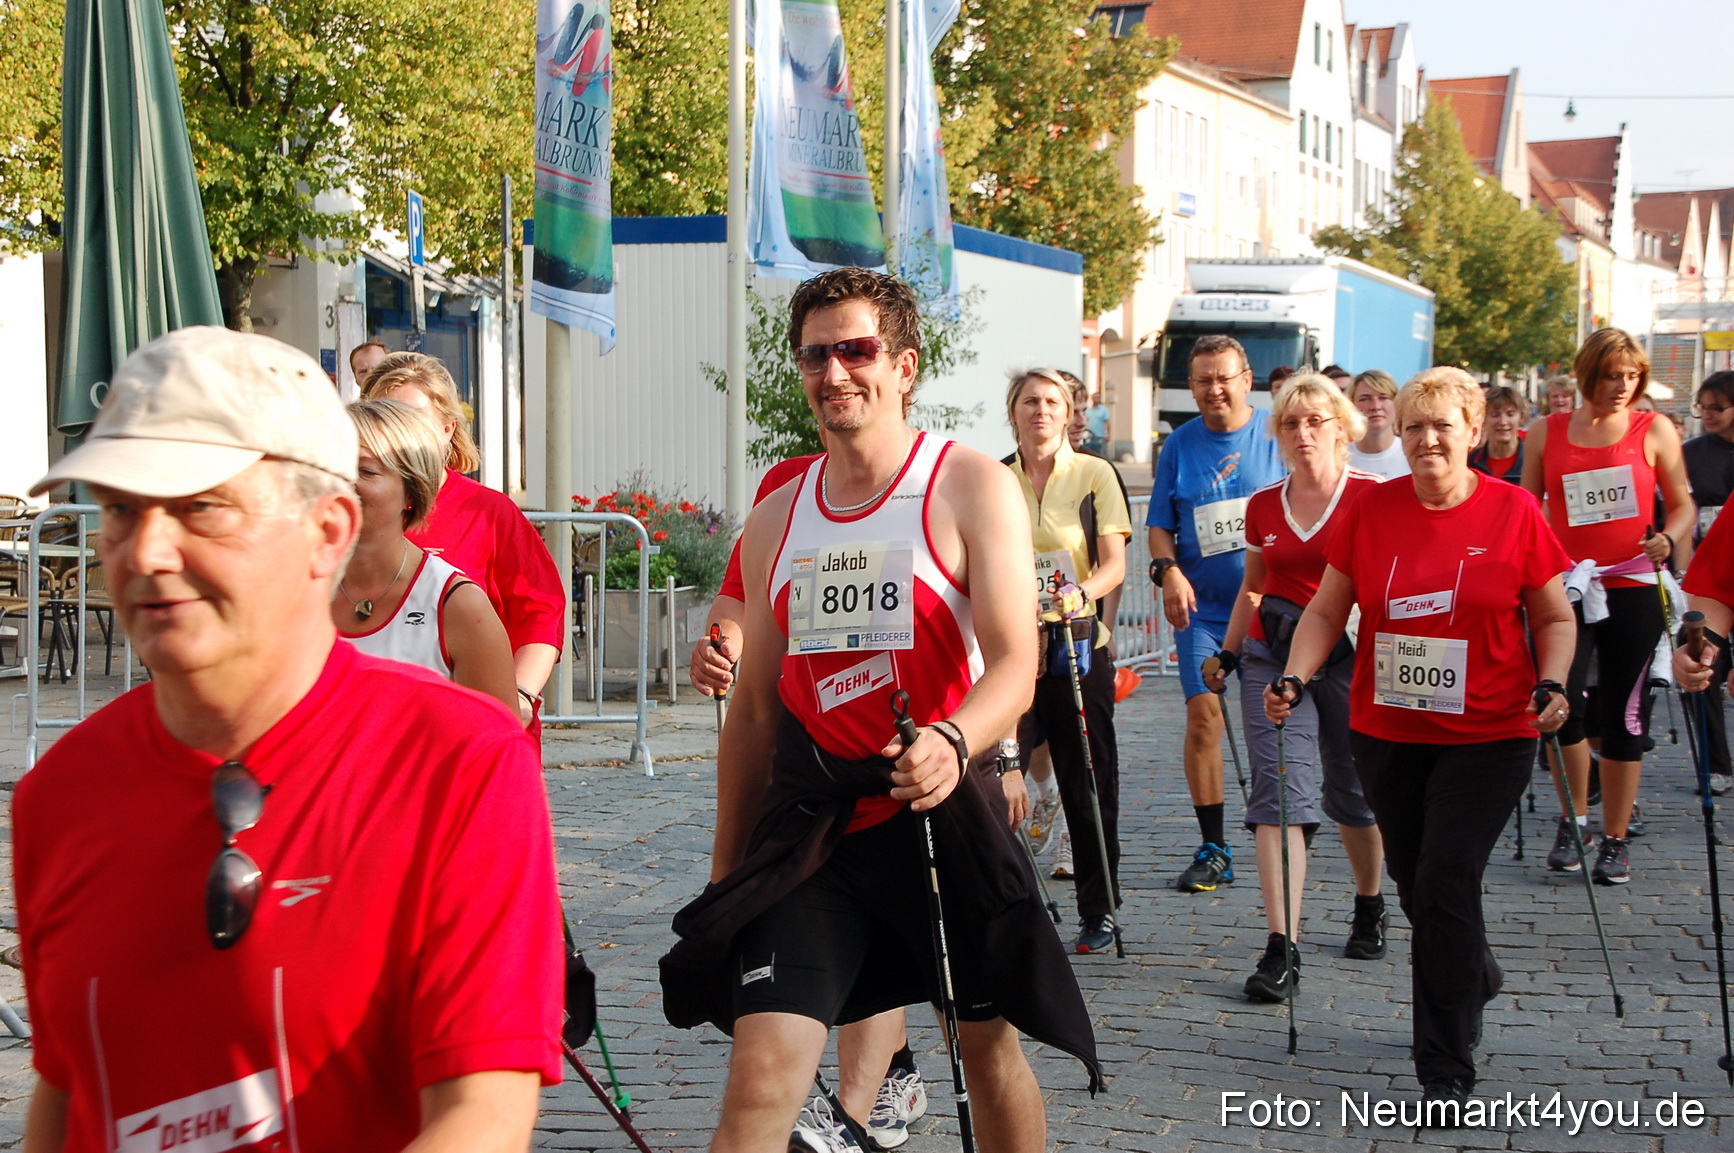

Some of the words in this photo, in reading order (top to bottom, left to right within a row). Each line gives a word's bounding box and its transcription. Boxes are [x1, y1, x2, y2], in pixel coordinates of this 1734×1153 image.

[536, 92, 609, 152] MARK
[781, 97, 863, 149] NEUMAR
[536, 137, 609, 180] ALBRUNN
[787, 142, 866, 172] MINERALBRU
[411, 202, 421, 257] P
[325, 305, 335, 329] 3
[1586, 486, 1627, 505] 8107
[822, 550, 867, 572] Jakob
[793, 586, 802, 601] N
[822, 581, 899, 614] 8018
[1406, 600, 1435, 612] DEHN
[861, 632, 911, 643] PFLEIDERER
[1398, 640, 1426, 657] Heidi
[1378, 660, 1384, 671] N
[1398, 664, 1456, 689] 8009
[835, 669, 870, 697] DEHN
[160, 1104, 231, 1151] DEHN
